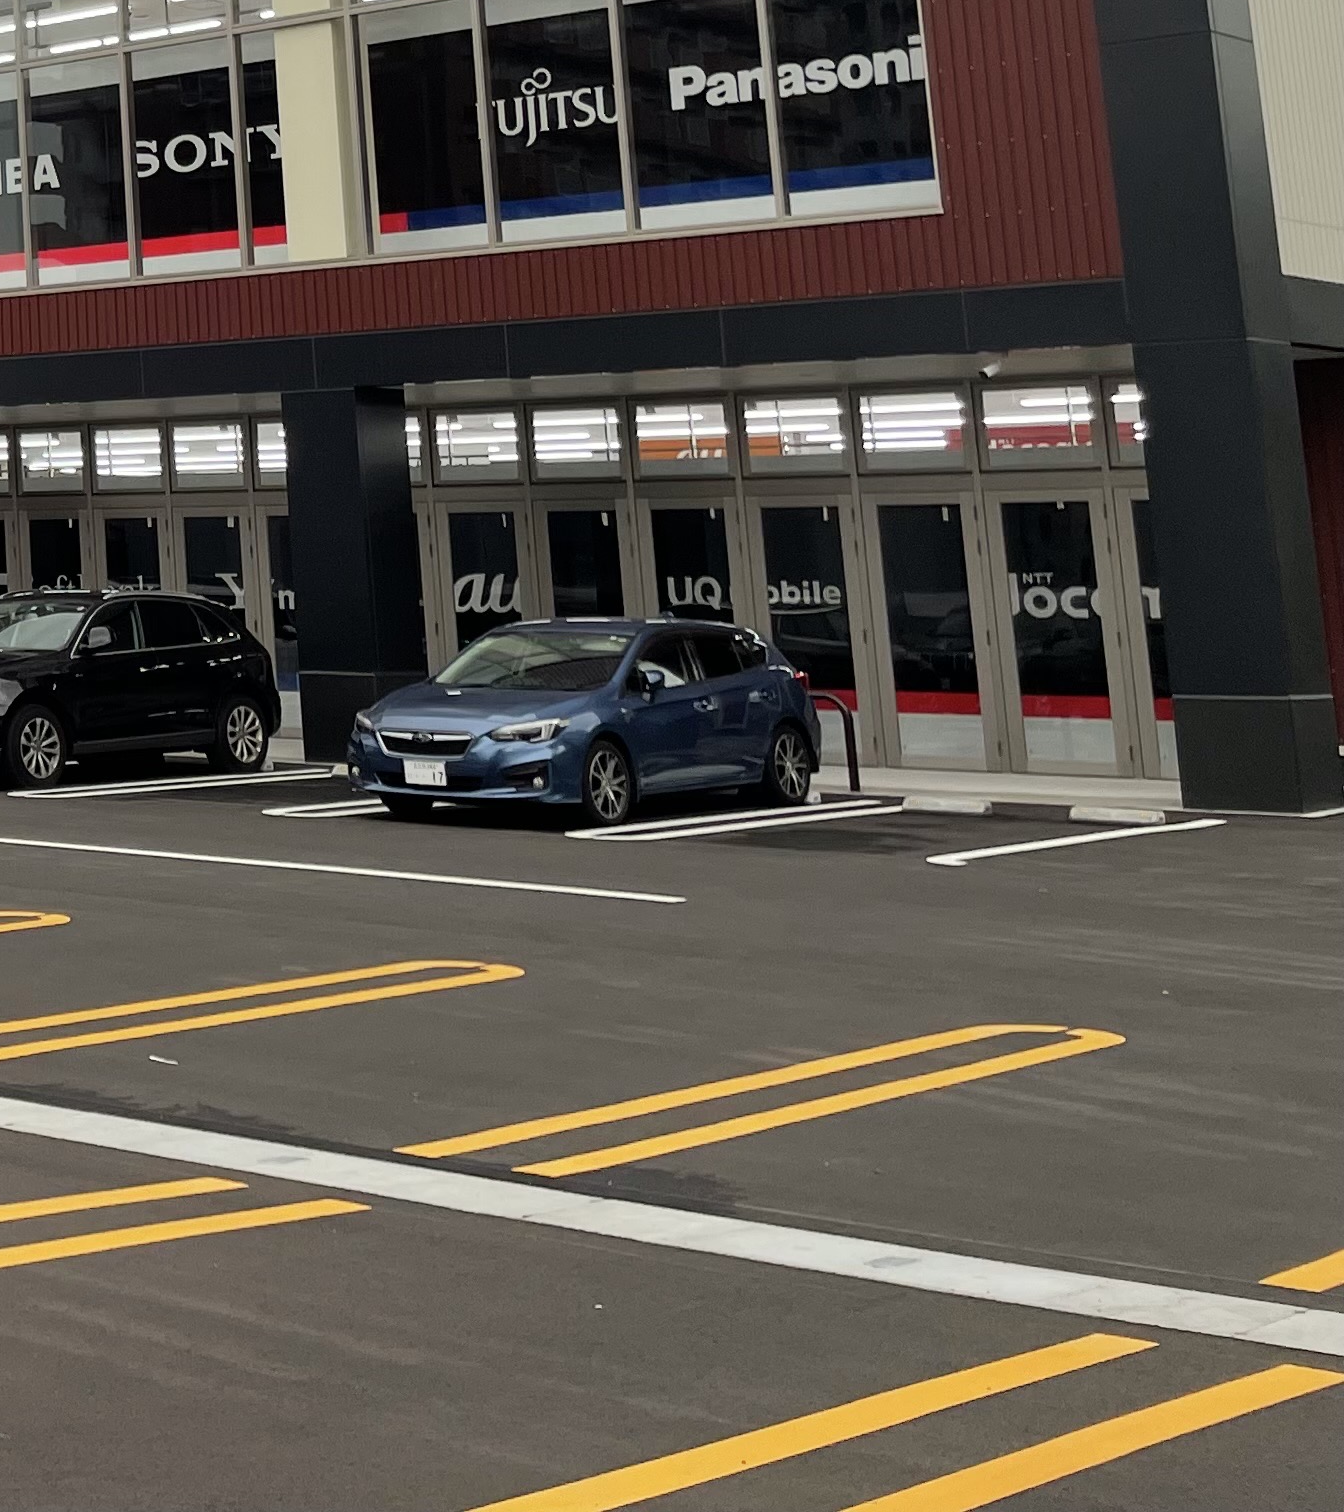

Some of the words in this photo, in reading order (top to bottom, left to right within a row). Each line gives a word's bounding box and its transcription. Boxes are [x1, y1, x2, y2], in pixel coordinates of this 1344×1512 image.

[669, 35, 925, 111] Panasoni
[476, 67, 618, 147] UJITSU
[454, 573, 520, 613] au
[667, 576, 721, 610] UQ
[730, 580, 841, 605] obile
[1022, 572, 1053, 584] NTT
